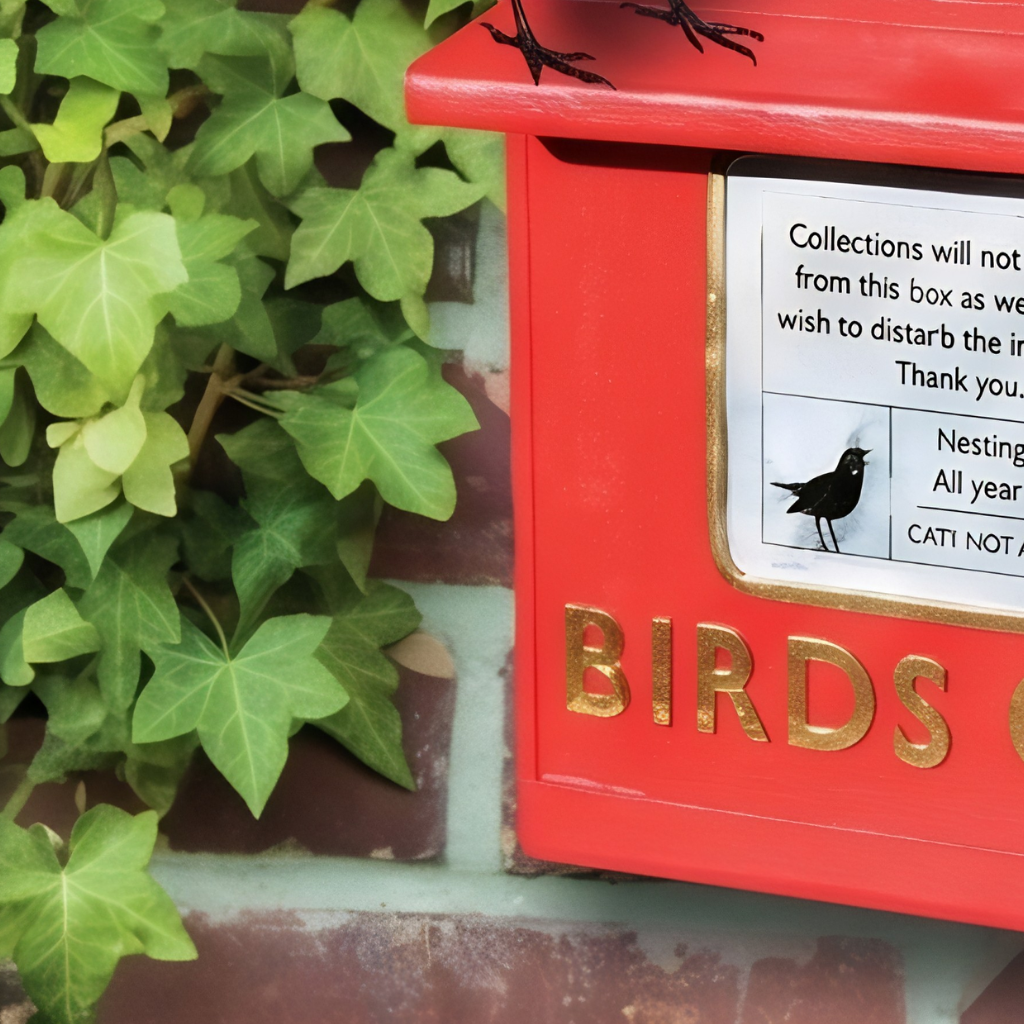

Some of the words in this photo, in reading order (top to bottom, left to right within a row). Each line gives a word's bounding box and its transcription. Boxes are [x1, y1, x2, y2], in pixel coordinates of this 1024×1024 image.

[789, 223, 923, 261] Collections
[931, 240, 971, 266] will
[981, 249, 1021, 271] not
[794, 264, 851, 295] from
[858, 272, 900, 300] this
[910, 277, 953, 307] box
[960, 291, 985, 311] as
[777, 308, 831, 335] wish
[838, 317, 863, 339] to
[962, 327, 1002, 355] the
[894, 360, 969, 393] Thank
[975, 376, 1024, 402] you.
[932, 468, 963, 495] All
[970, 479, 1023, 505] year
[966, 531, 1015, 555] NOT
[563, 602, 951, 770] BIRDS
